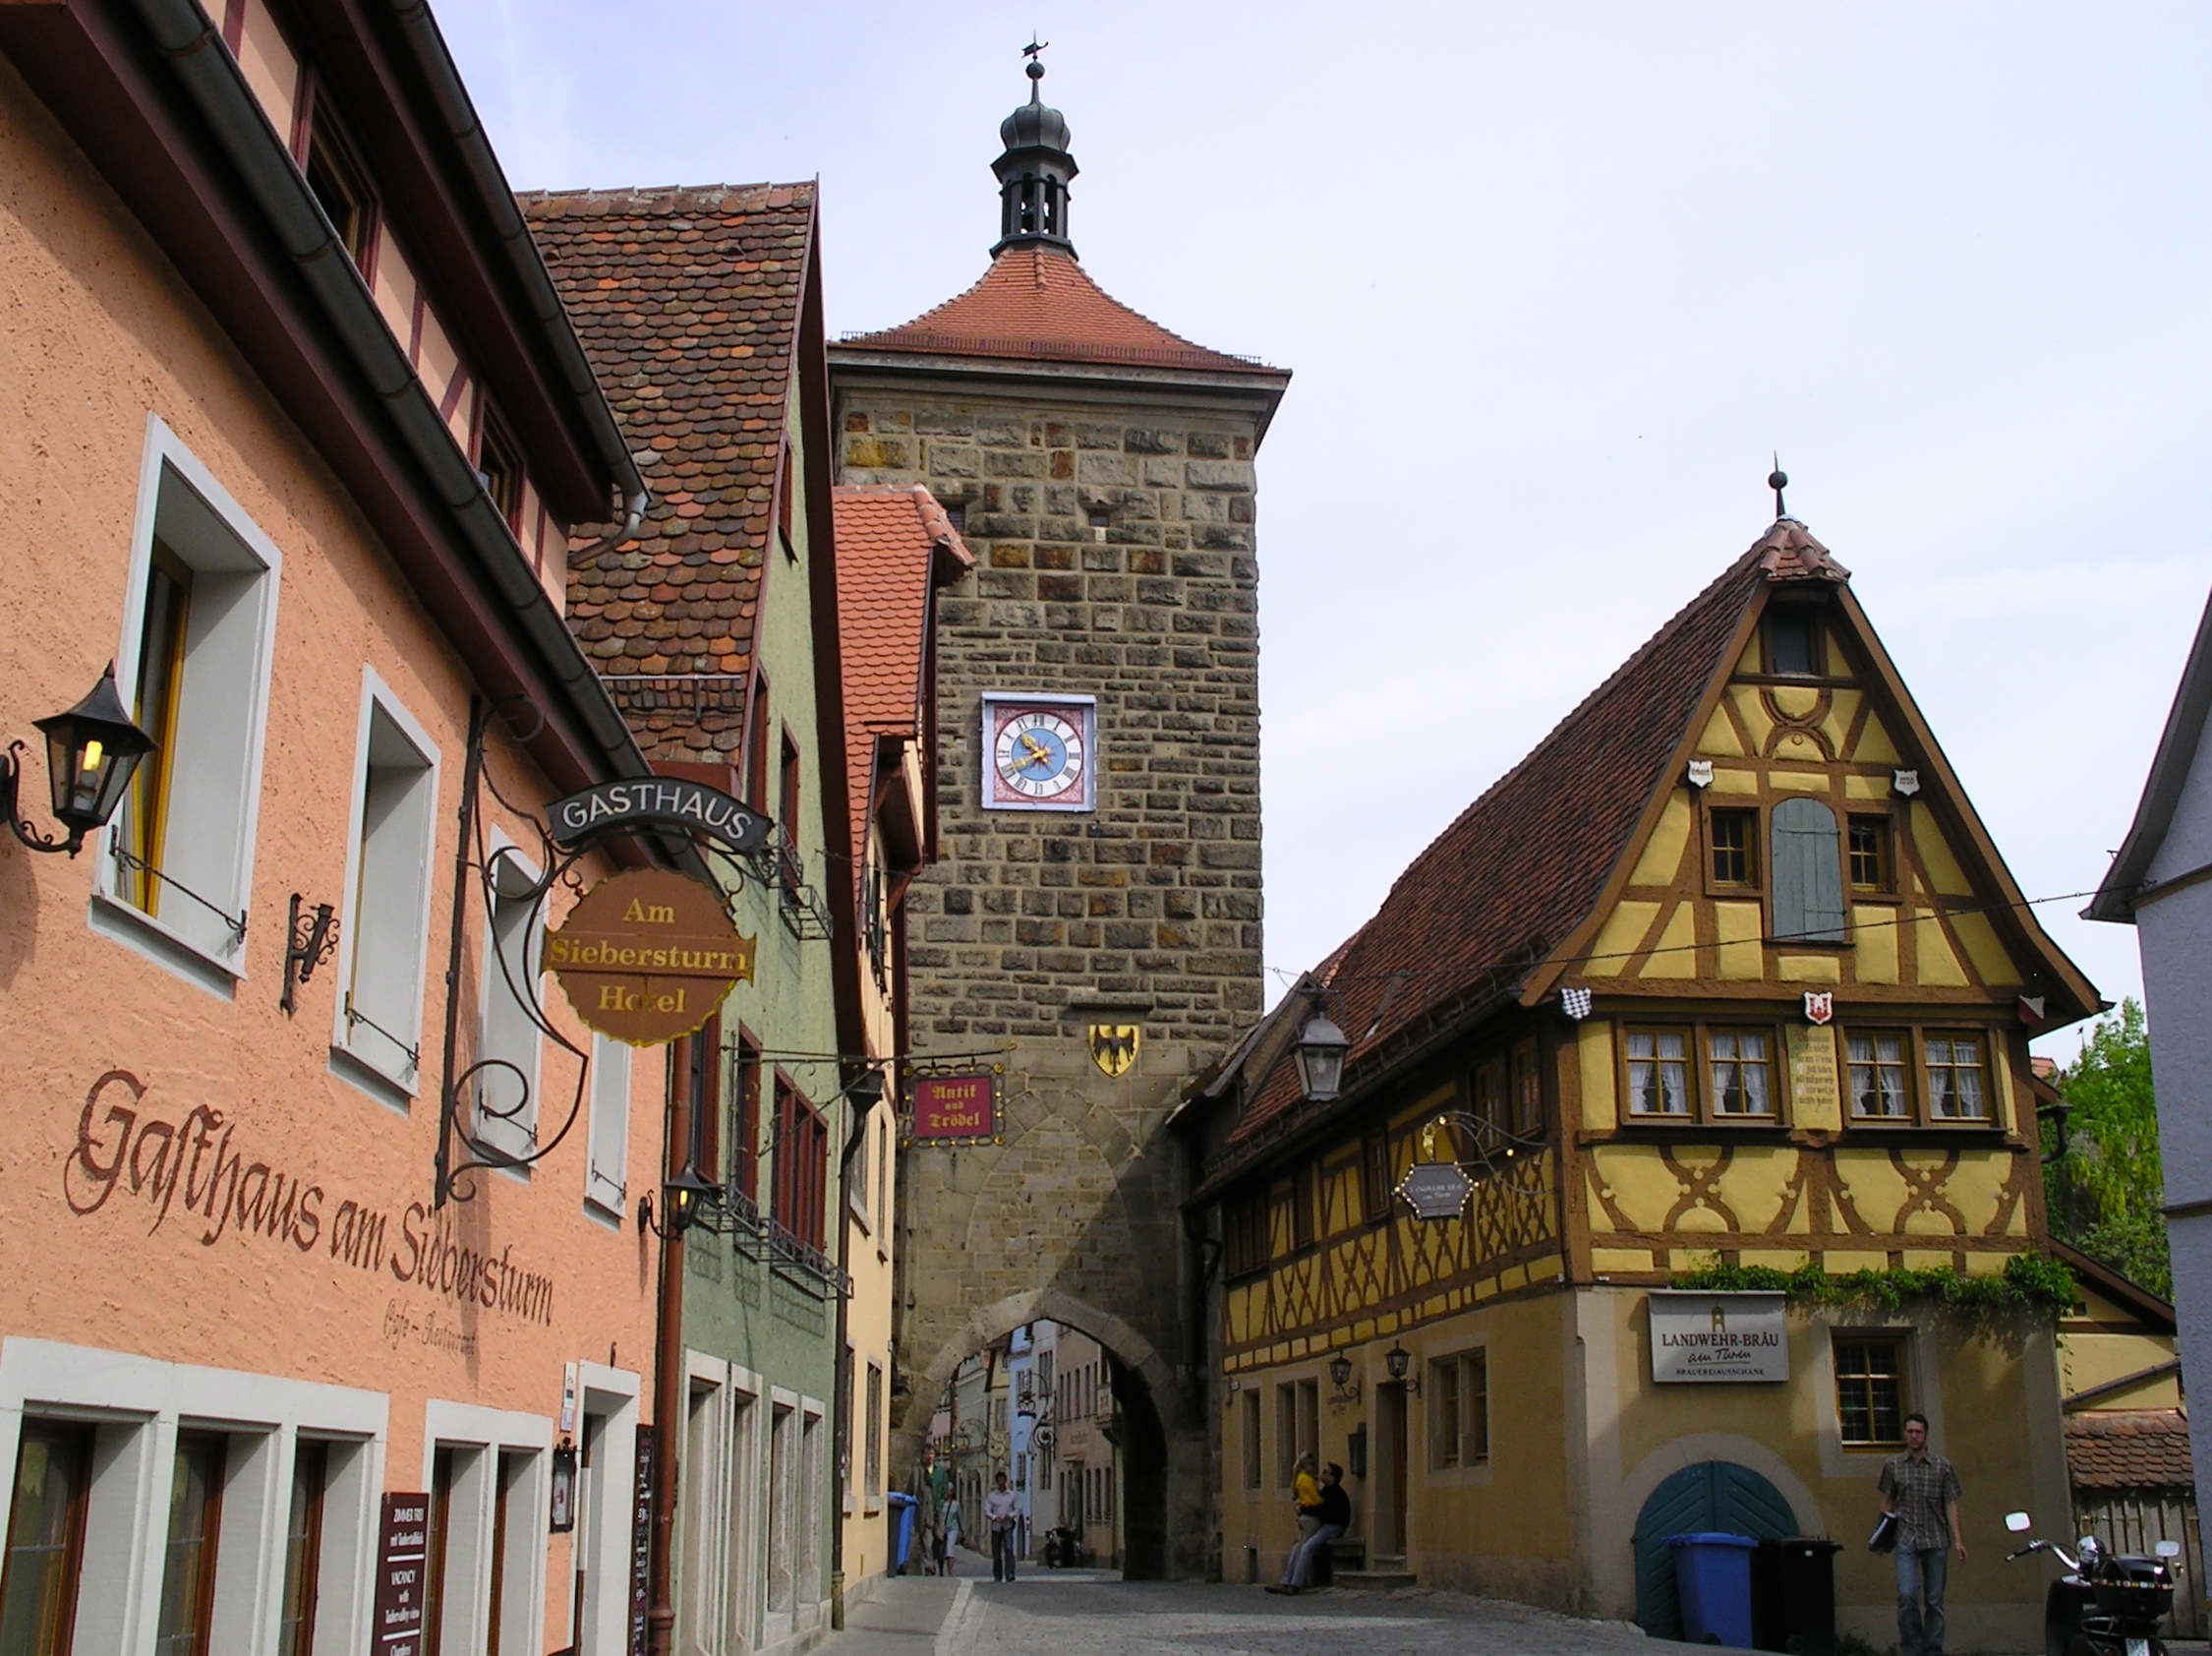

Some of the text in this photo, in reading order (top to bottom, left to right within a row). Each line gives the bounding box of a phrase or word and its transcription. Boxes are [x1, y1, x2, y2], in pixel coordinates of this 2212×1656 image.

[562, 784, 753, 840] GASTHAUS
[622, 898, 675, 924] Am
[550, 939, 747, 971] Siebersturm
[932, 1085, 977, 1099] Antik
[945, 1100, 964, 1110] und
[929, 1112, 980, 1128] Trödel
[331, 1200, 387, 1272] am
[390, 1202, 553, 1328] Siebersturm
[1661, 1331, 1779, 1347] LANDWEHR-BRÄU
